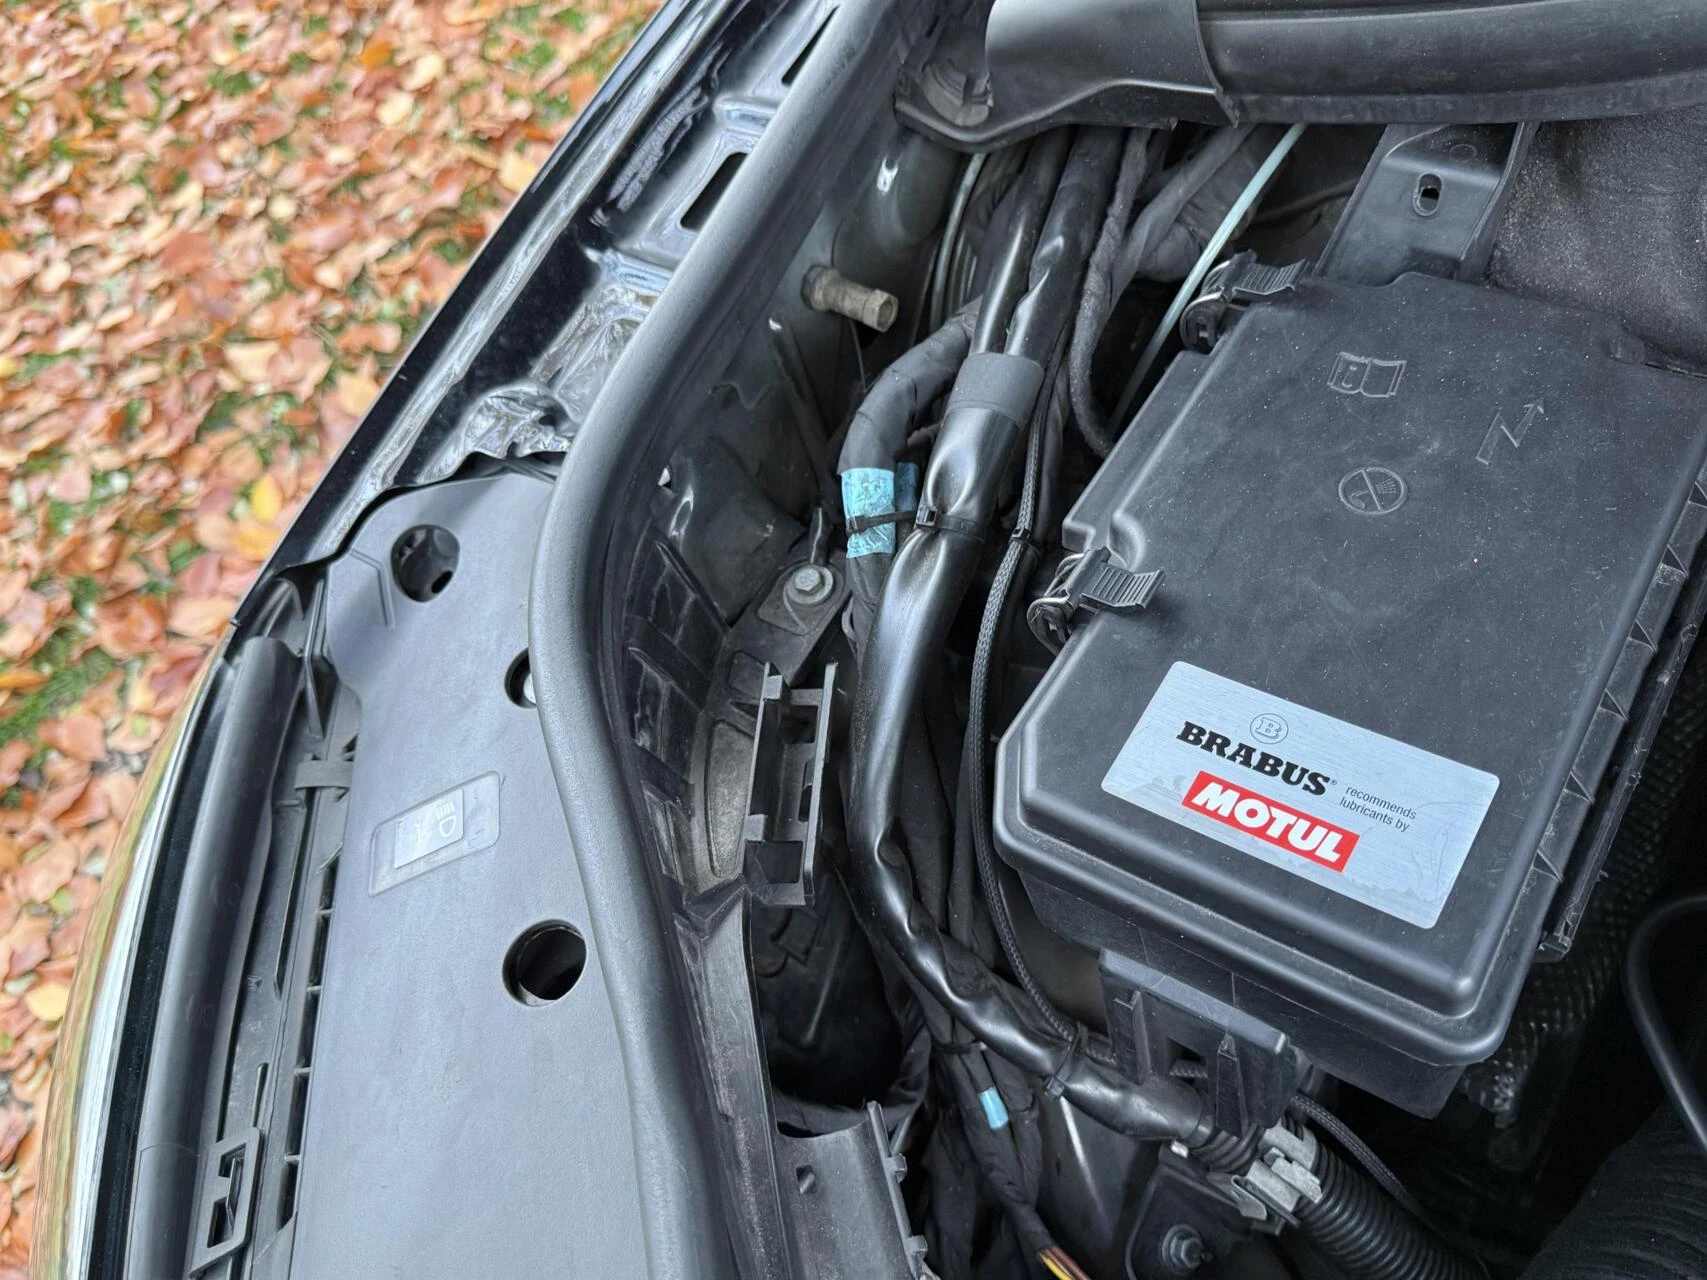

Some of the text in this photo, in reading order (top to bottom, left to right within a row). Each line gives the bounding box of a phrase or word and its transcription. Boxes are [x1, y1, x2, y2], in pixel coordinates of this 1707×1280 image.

[1339, 797, 1410, 832] lubricants by
[1345, 786, 1417, 820] recommends
[1191, 782, 1344, 863] MOTUL
